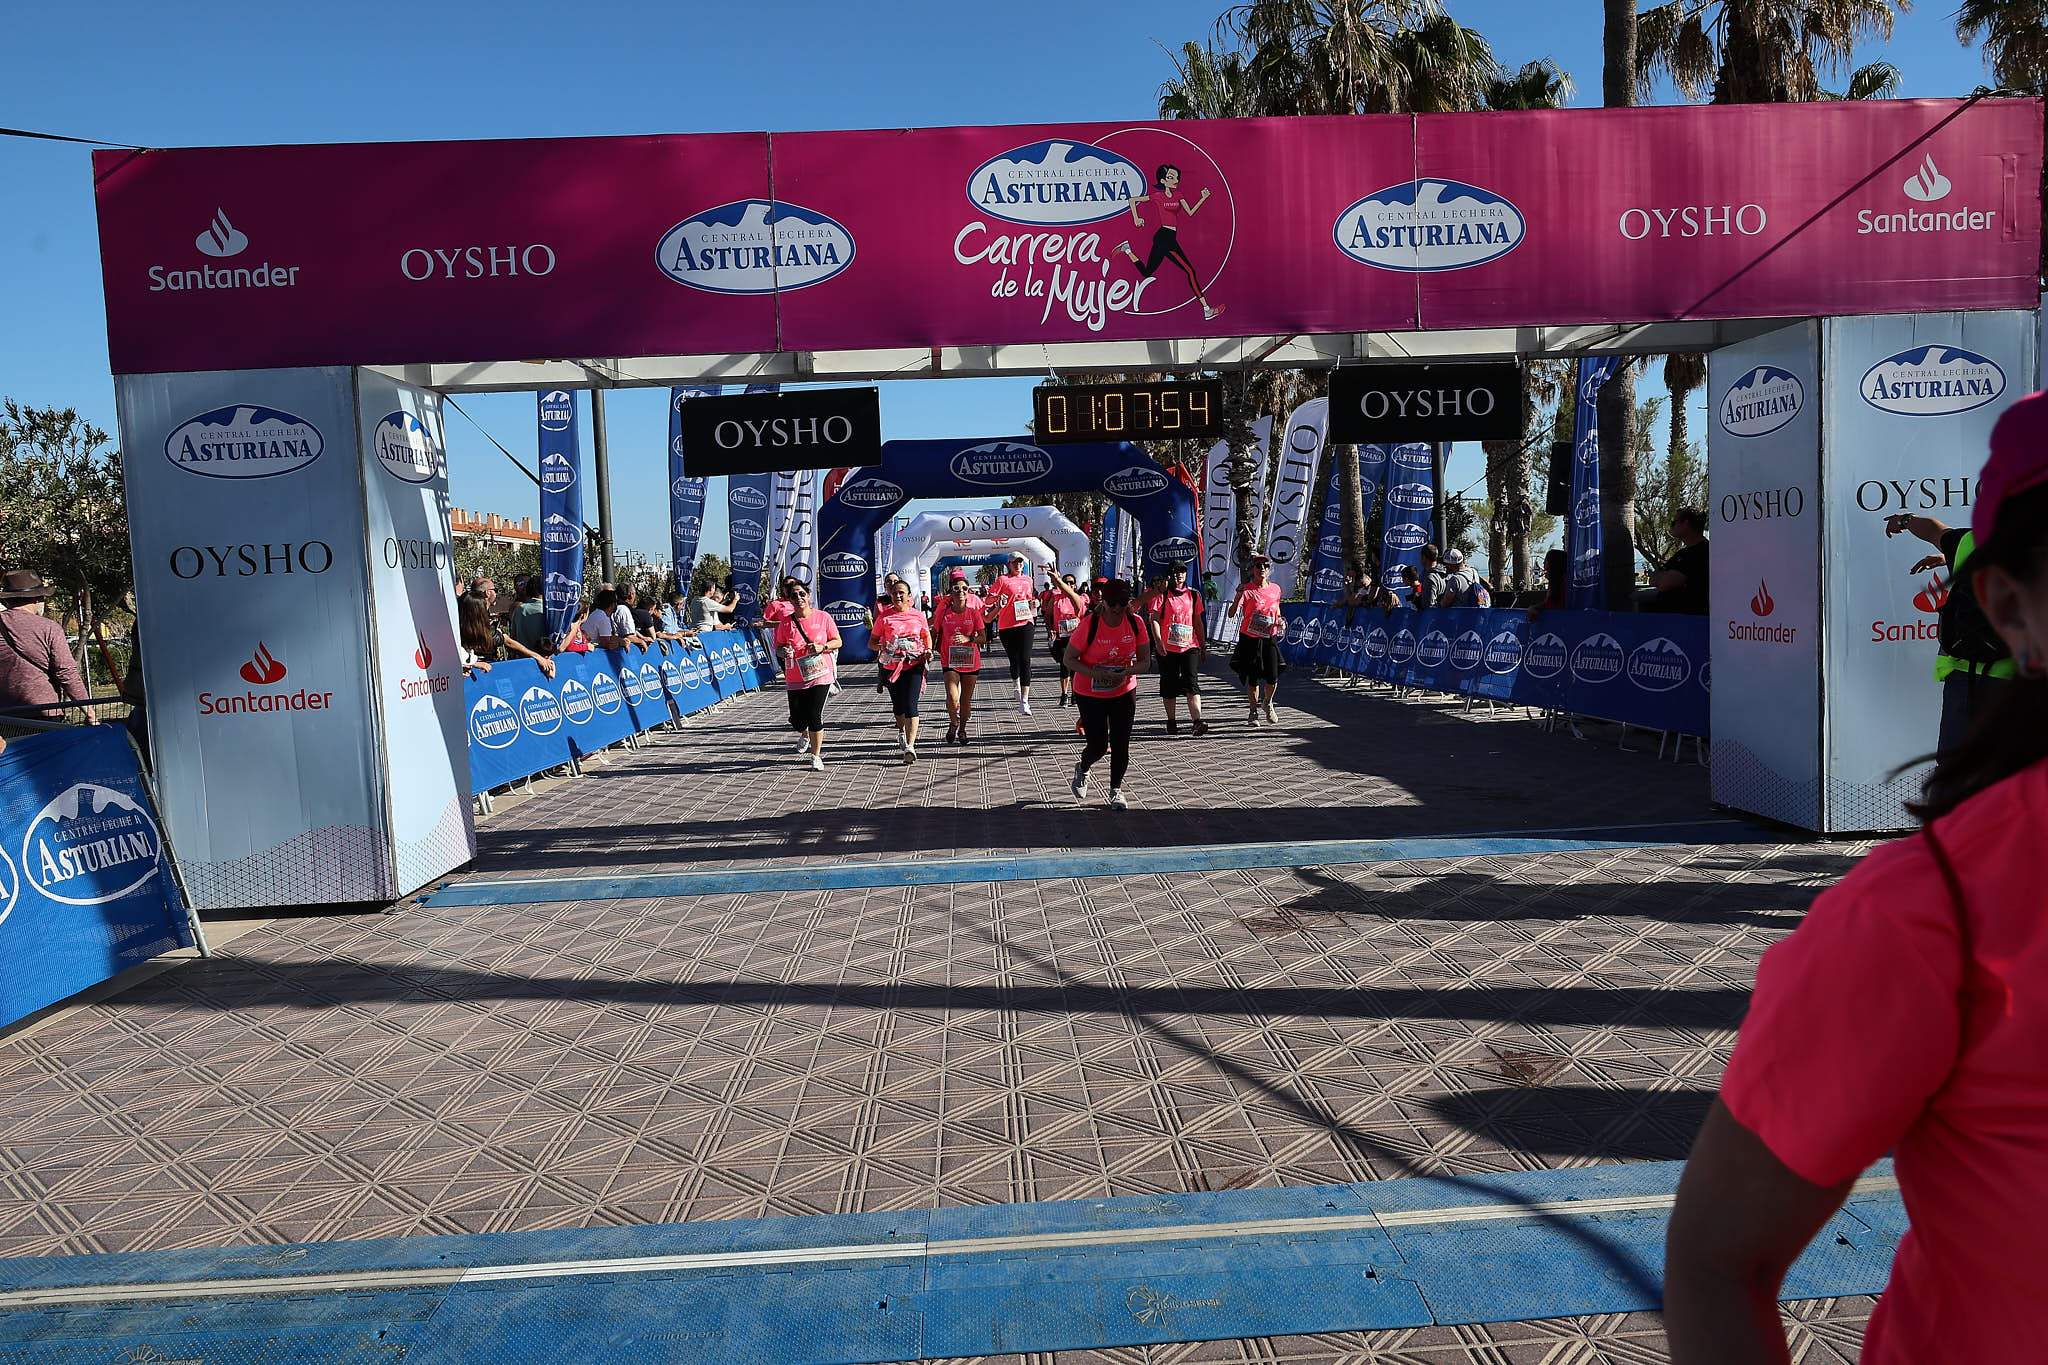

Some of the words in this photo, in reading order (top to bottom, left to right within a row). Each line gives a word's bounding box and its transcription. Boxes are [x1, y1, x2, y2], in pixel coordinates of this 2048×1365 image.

[1008, 170, 1064, 178] CENTRAL
[1070, 168, 1126, 177] LECHERA
[981, 172, 1132, 204] ASTURIANA
[1377, 211, 1437, 221] CENTRAL
[1443, 208, 1504, 219] LECHERA
[1619, 204, 1767, 240] OYSHO
[1857, 206, 1995, 235] Santander
[701, 232, 764, 243] CENTRAL
[953, 221, 1101, 265] Carrera
[1349, 214, 1511, 249] ASTURIANA
[401, 243, 556, 281] OYSHO
[672, 237, 840, 272] ASTURIANA
[149, 262, 300, 292] Santander
[991, 268, 1019, 298] de
[1024, 266, 1044, 297] la
[1041, 258, 1157, 332] Mujer
[1870, 373, 1995, 400] ASTURIANA
[1048, 391, 1209, 433] 01:07:54
[1360, 388, 1495, 420] OYSHO
[1725, 392, 1798, 425] ASTURIANA
[200, 430, 251, 440] CENTRAL
[255, 428, 306, 438] LECHERA
[714, 415, 853, 449] OYSHO
[178, 434, 313, 462] ASTURIANA
[380, 431, 436, 470] ASTURIANA
[959, 456, 1046, 475] ASTURIANA
[844, 490, 899, 502] ASTURIANA
[1109, 478, 1165, 492] ASTURIANA
[1269, 425, 1319, 564] OYSHO
[1856, 478, 1983, 512] OYSH
[1721, 486, 1804, 523] OYSHO
[949, 514, 1028, 533] OYSHO
[170, 541, 333, 579] OYSHO
[384, 538, 446, 570] OYSHO
[822, 563, 865, 572] ASTURIANA
[1728, 620, 1796, 644] Santander
[1872, 619, 1939, 642] Santa
[1573, 650, 1618, 672] ASTURIANA
[1630, 654, 1682, 680] ASTURIANA
[199, 689, 333, 715] Santander
[400, 676, 450, 700] Santander
[475, 716, 518, 740] ASTURIANA
[54, 823, 100, 843] CENTRAL
